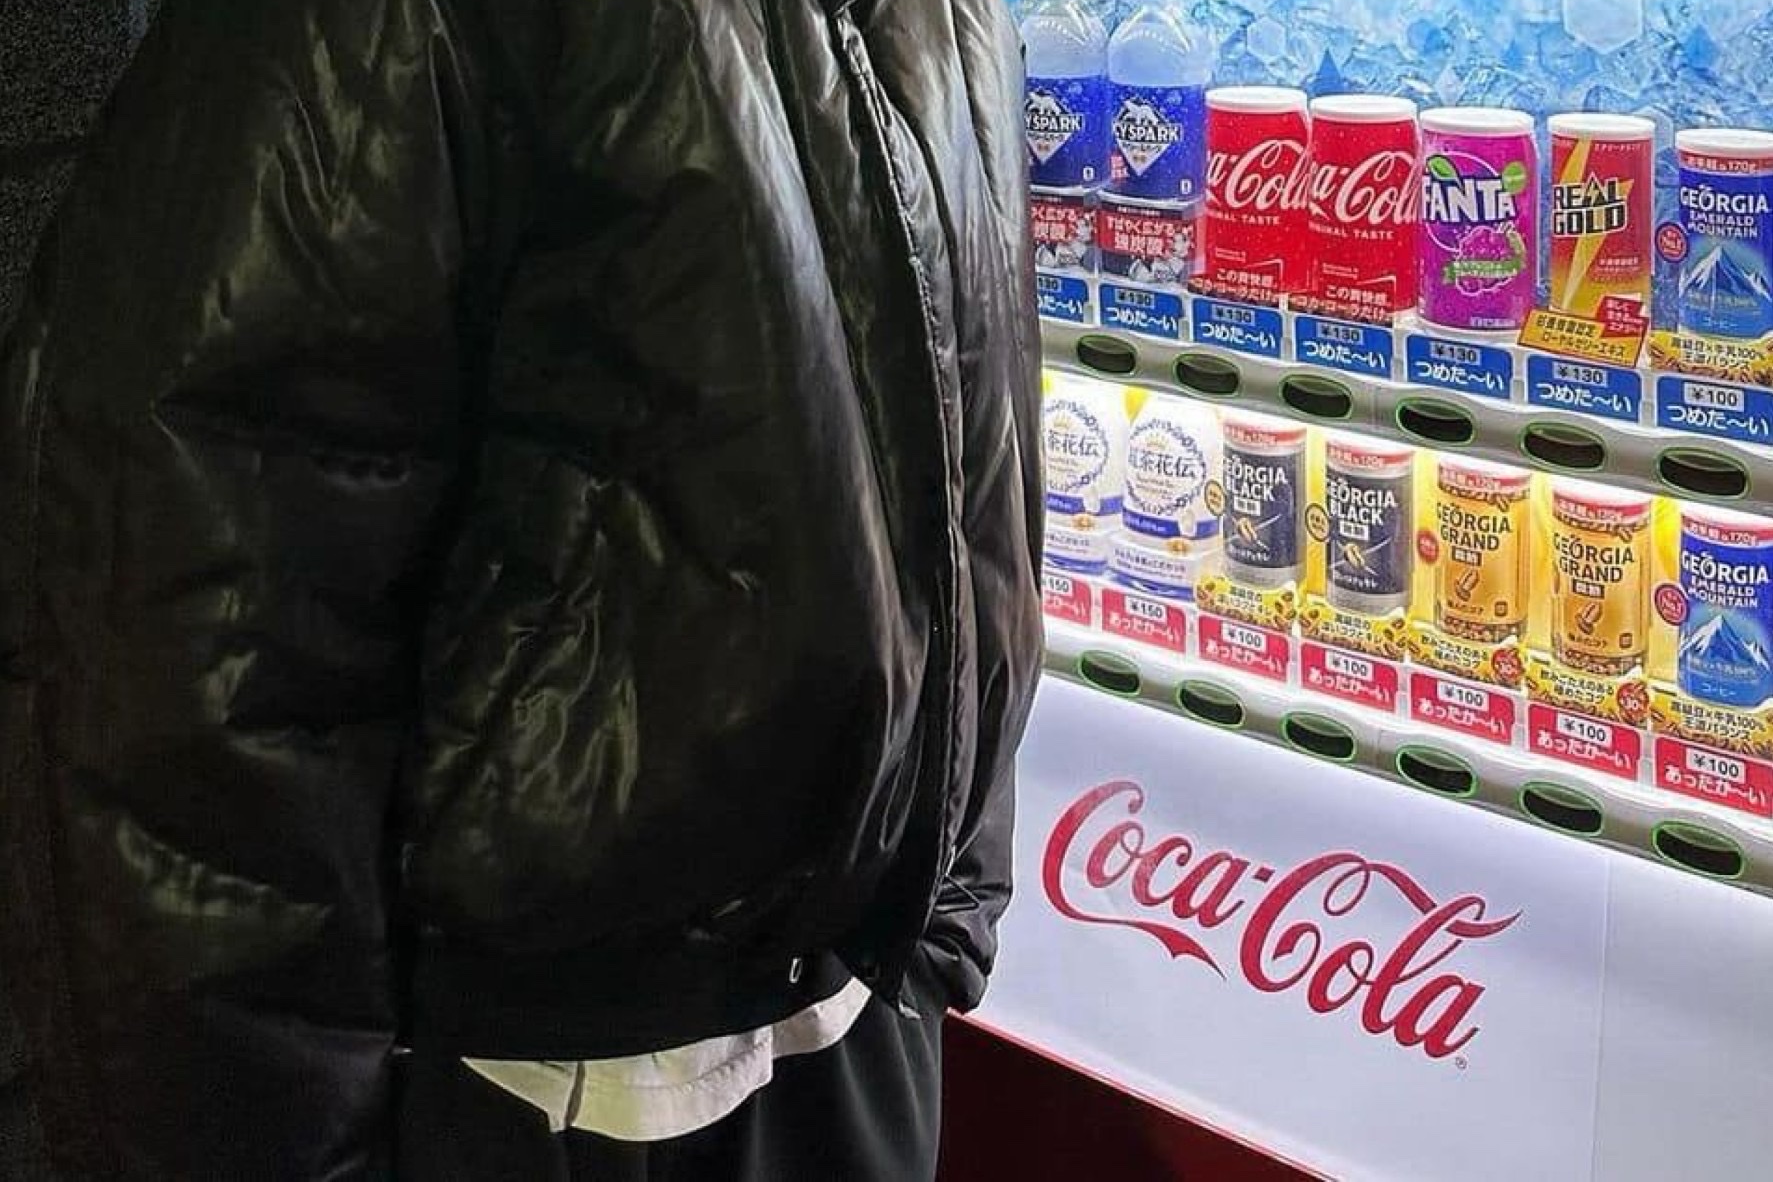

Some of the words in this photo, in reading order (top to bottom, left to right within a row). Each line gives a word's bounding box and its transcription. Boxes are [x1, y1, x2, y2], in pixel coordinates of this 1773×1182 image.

[1421, 175, 1516, 223] FANTA
[1553, 172, 1627, 209] REAL
[1553, 202, 1626, 237] GOLD
[1687, 221, 1758, 239] MOUNTAIN
[1433, 344, 1477, 365] ¥130
[1557, 366, 1603, 384] ¥130
[1692, 387, 1738, 407] ¥100
[1440, 525, 1500, 551] GRAND
[1558, 556, 1624, 583] GRAND
[1687, 586, 1758, 608] MOUNTAIN
[1691, 575, 1755, 597] EMERALD
[1129, 602, 1163, 619] ¥150
[1227, 628, 1262, 648] ¥100
[1331, 654, 1368, 677] ¥100
[1445, 683, 1484, 707] ¥100
[1563, 718, 1606, 742] ¥100
[1693, 753, 1739, 778] ¥100
[1042, 780, 1524, 1059] Coca-Cola
